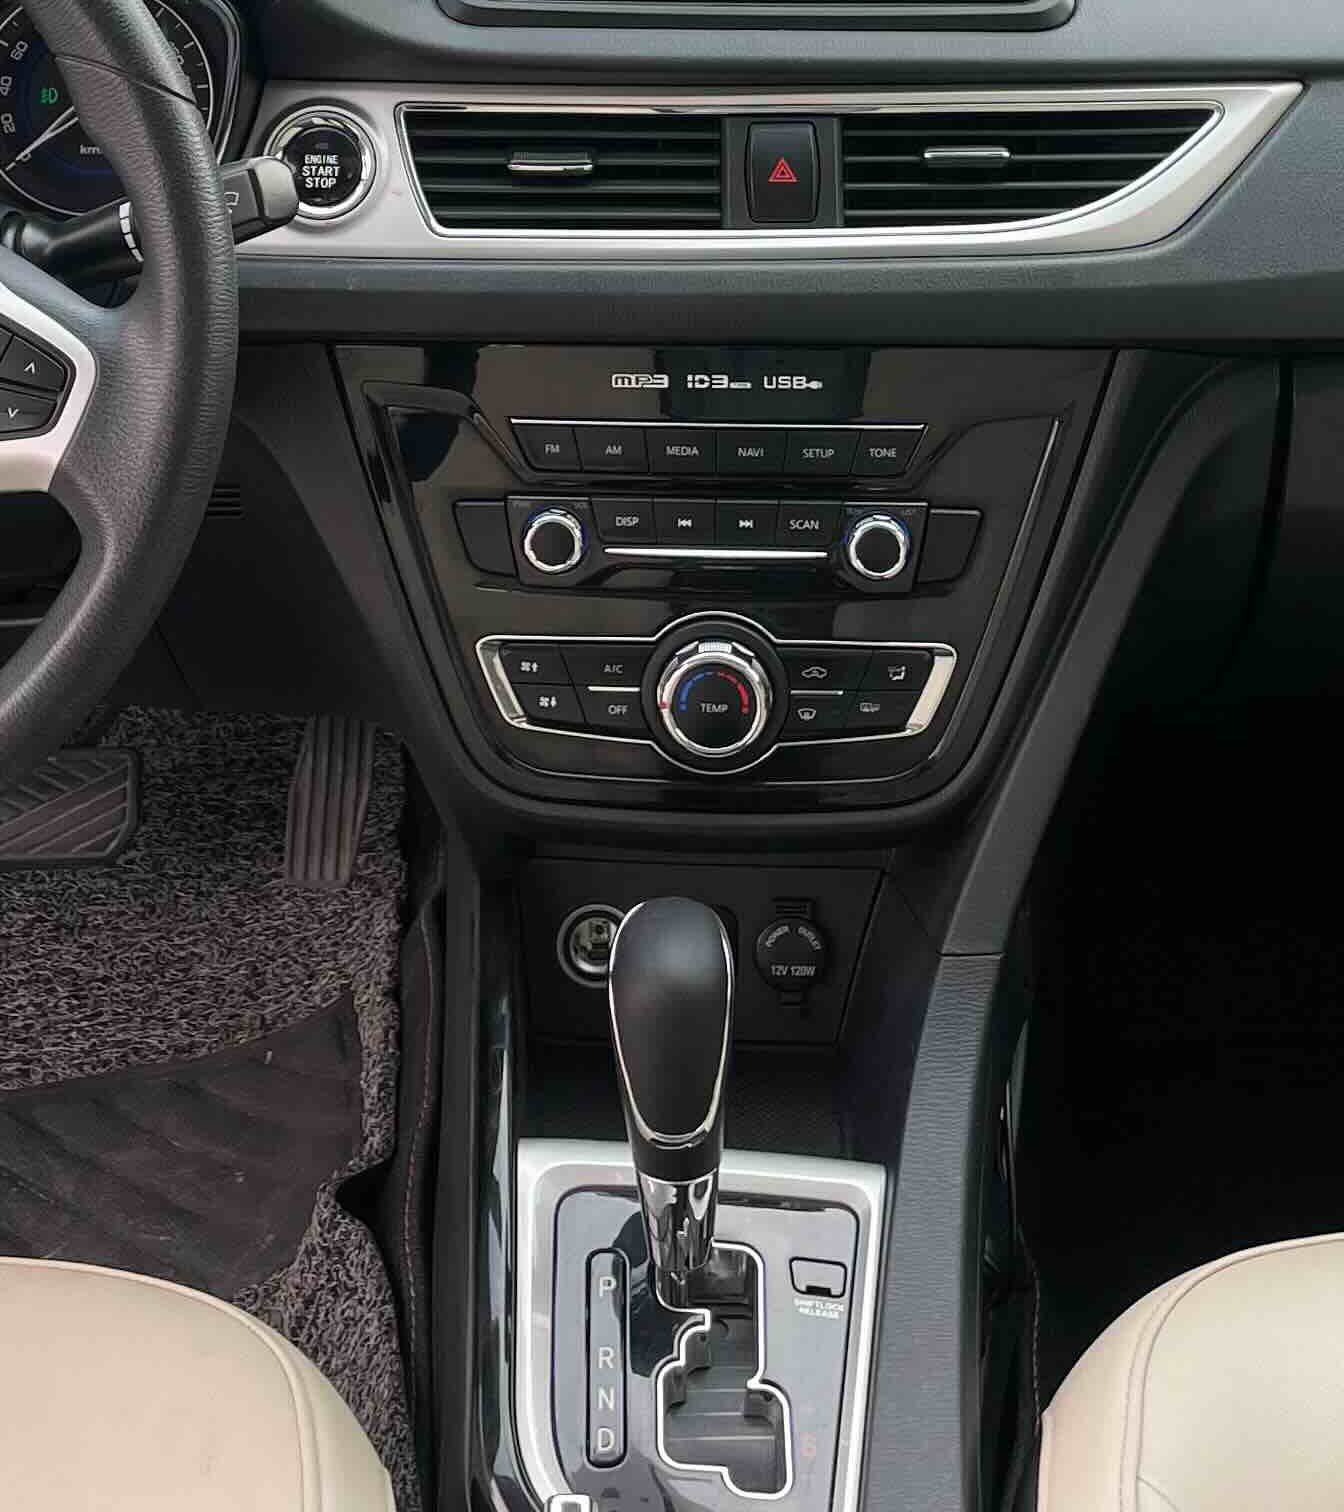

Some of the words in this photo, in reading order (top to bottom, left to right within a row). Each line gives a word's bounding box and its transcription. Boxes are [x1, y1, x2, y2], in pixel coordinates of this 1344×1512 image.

[304, 154, 339, 165] ENGINE
[302, 166, 340, 177] START
[305, 177, 336, 188] STOP
[763, 375, 806, 389] USB
[545, 444, 561, 455] FM
[605, 444, 622, 455] AM
[666, 445, 699, 456] MEDIA
[737, 447, 764, 457] NAVI
[802, 448, 835, 459] SETUP
[869, 448, 897, 458] TONE
[615, 516, 640, 527] DISP
[789, 519, 820, 530] SCAN
[608, 704, 629, 715] OFF
[700, 703, 729, 714] TEMP
[599, 1275, 616, 1298] P
[598, 1346, 614, 1369] R
[598, 1389, 615, 1411] N
[597, 1428, 615, 1452] D
